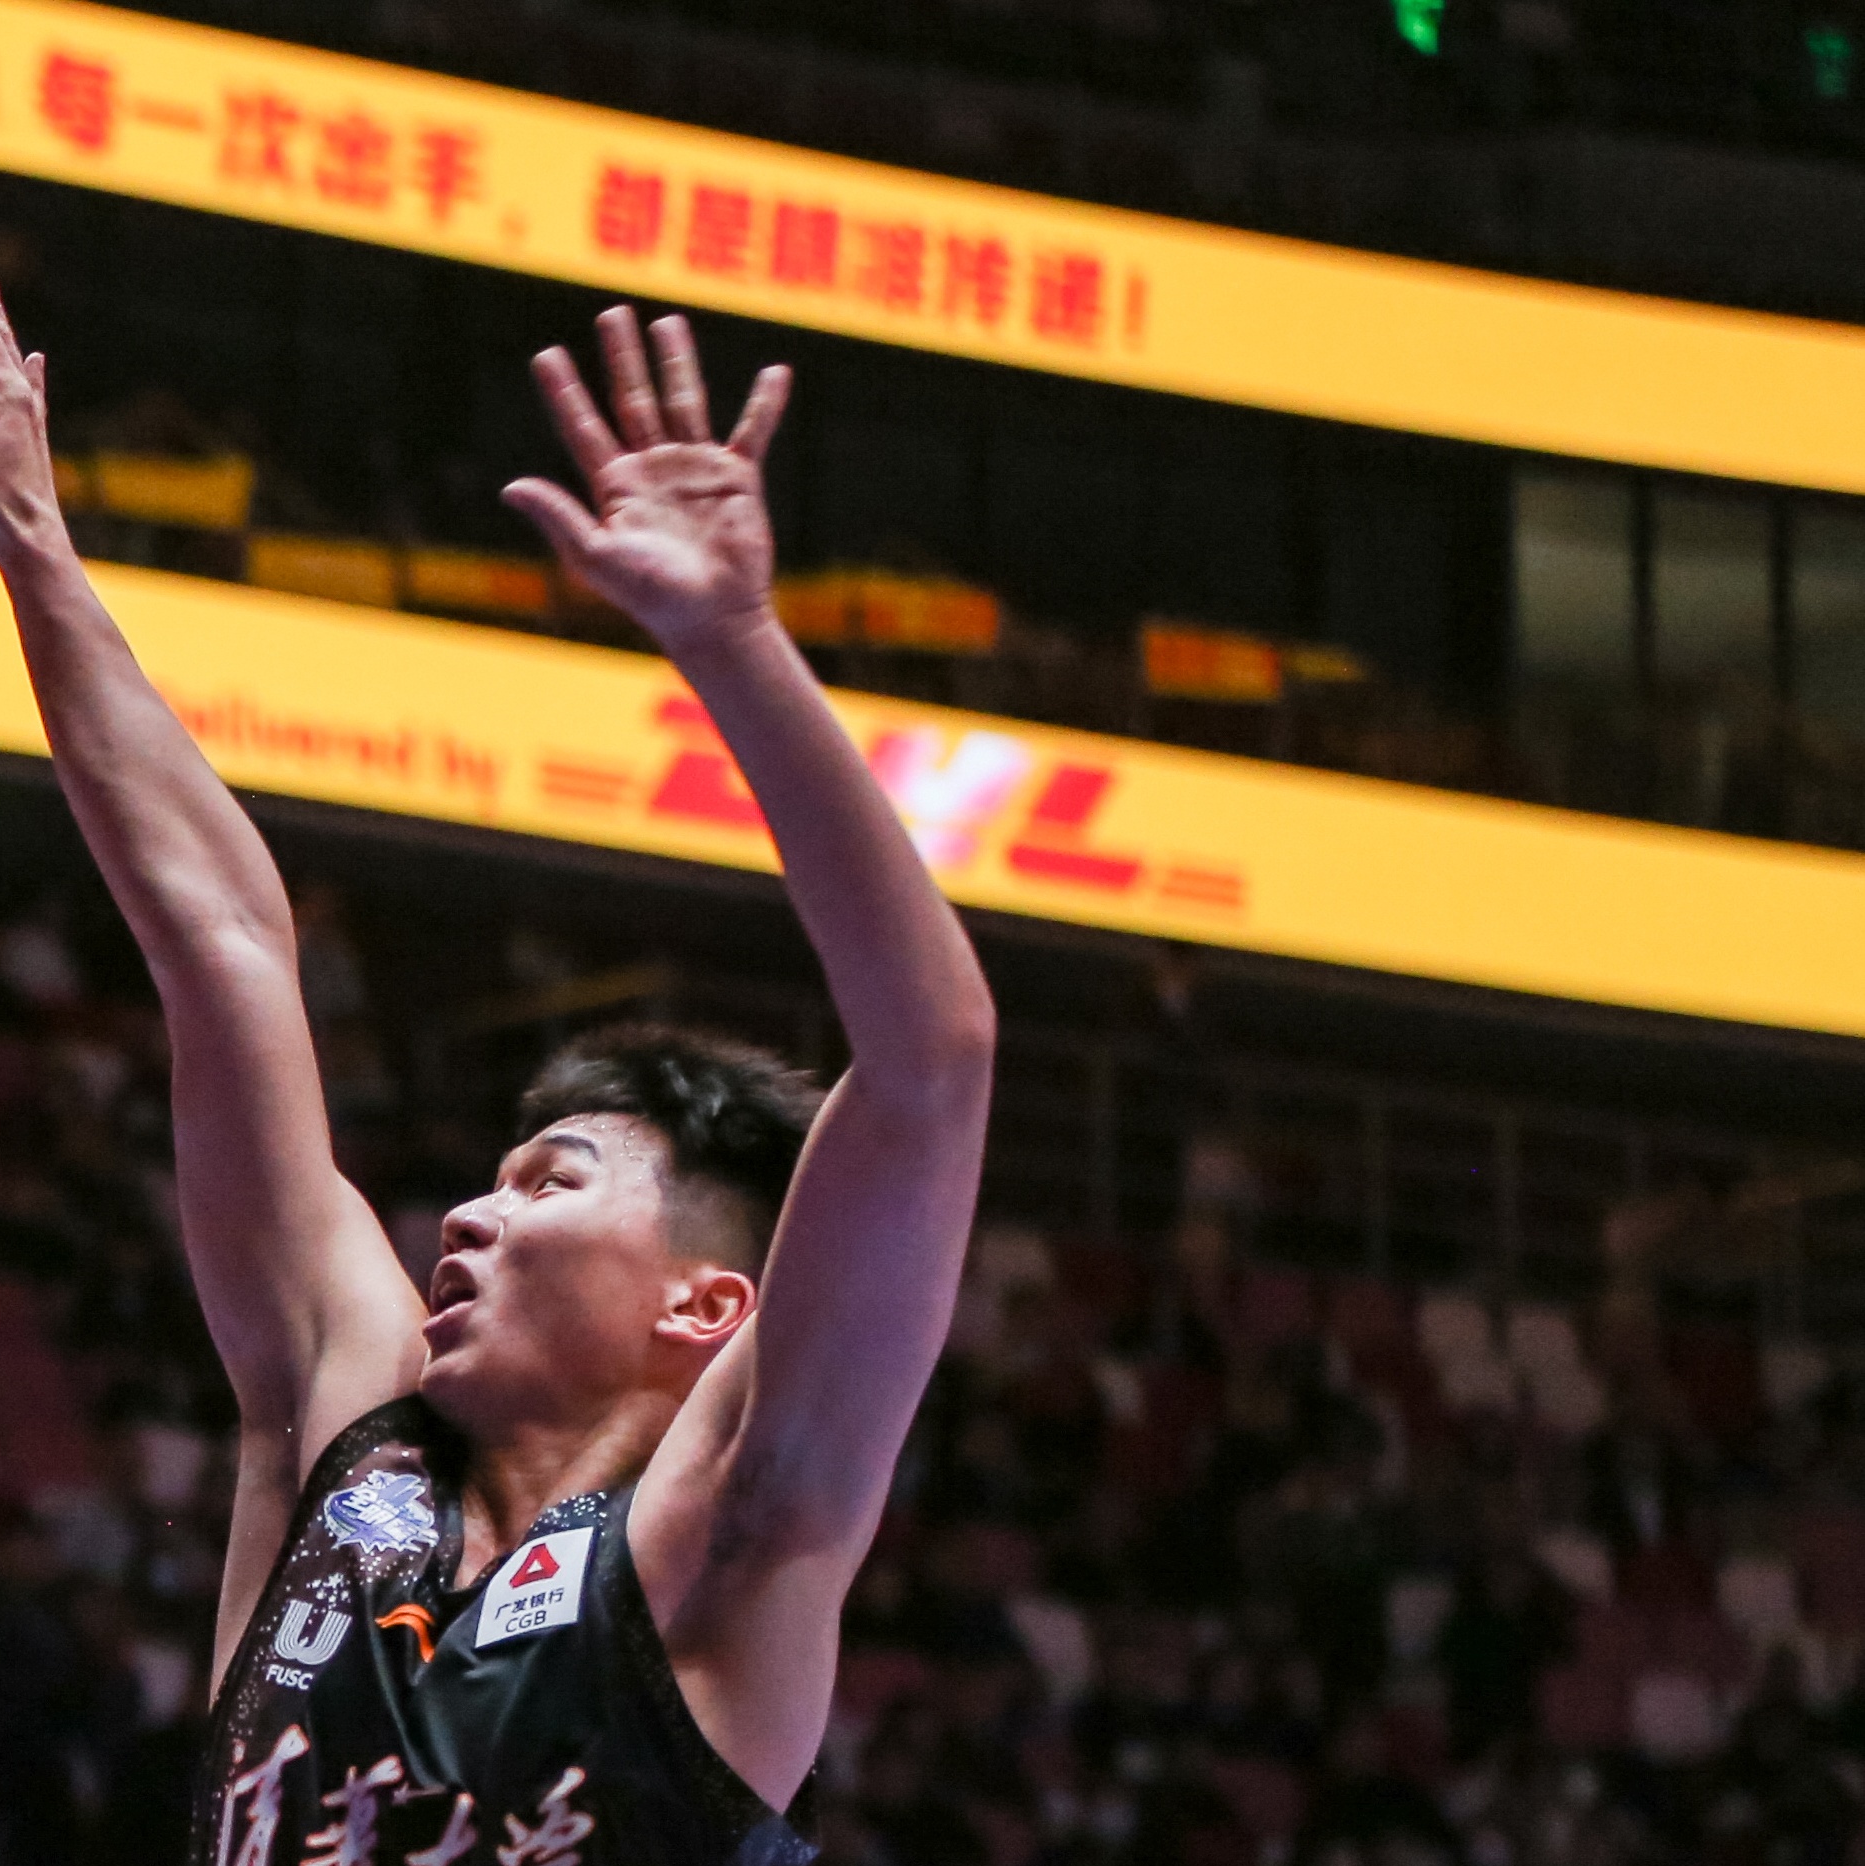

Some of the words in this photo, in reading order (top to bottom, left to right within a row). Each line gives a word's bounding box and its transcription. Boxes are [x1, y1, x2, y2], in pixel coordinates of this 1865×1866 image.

[157, 674, 415, 772] elivered
[493, 1587, 565, 1621] 广发银行
[504, 1612, 549, 1634] CGB
[266, 1663, 314, 1691] FUSC
